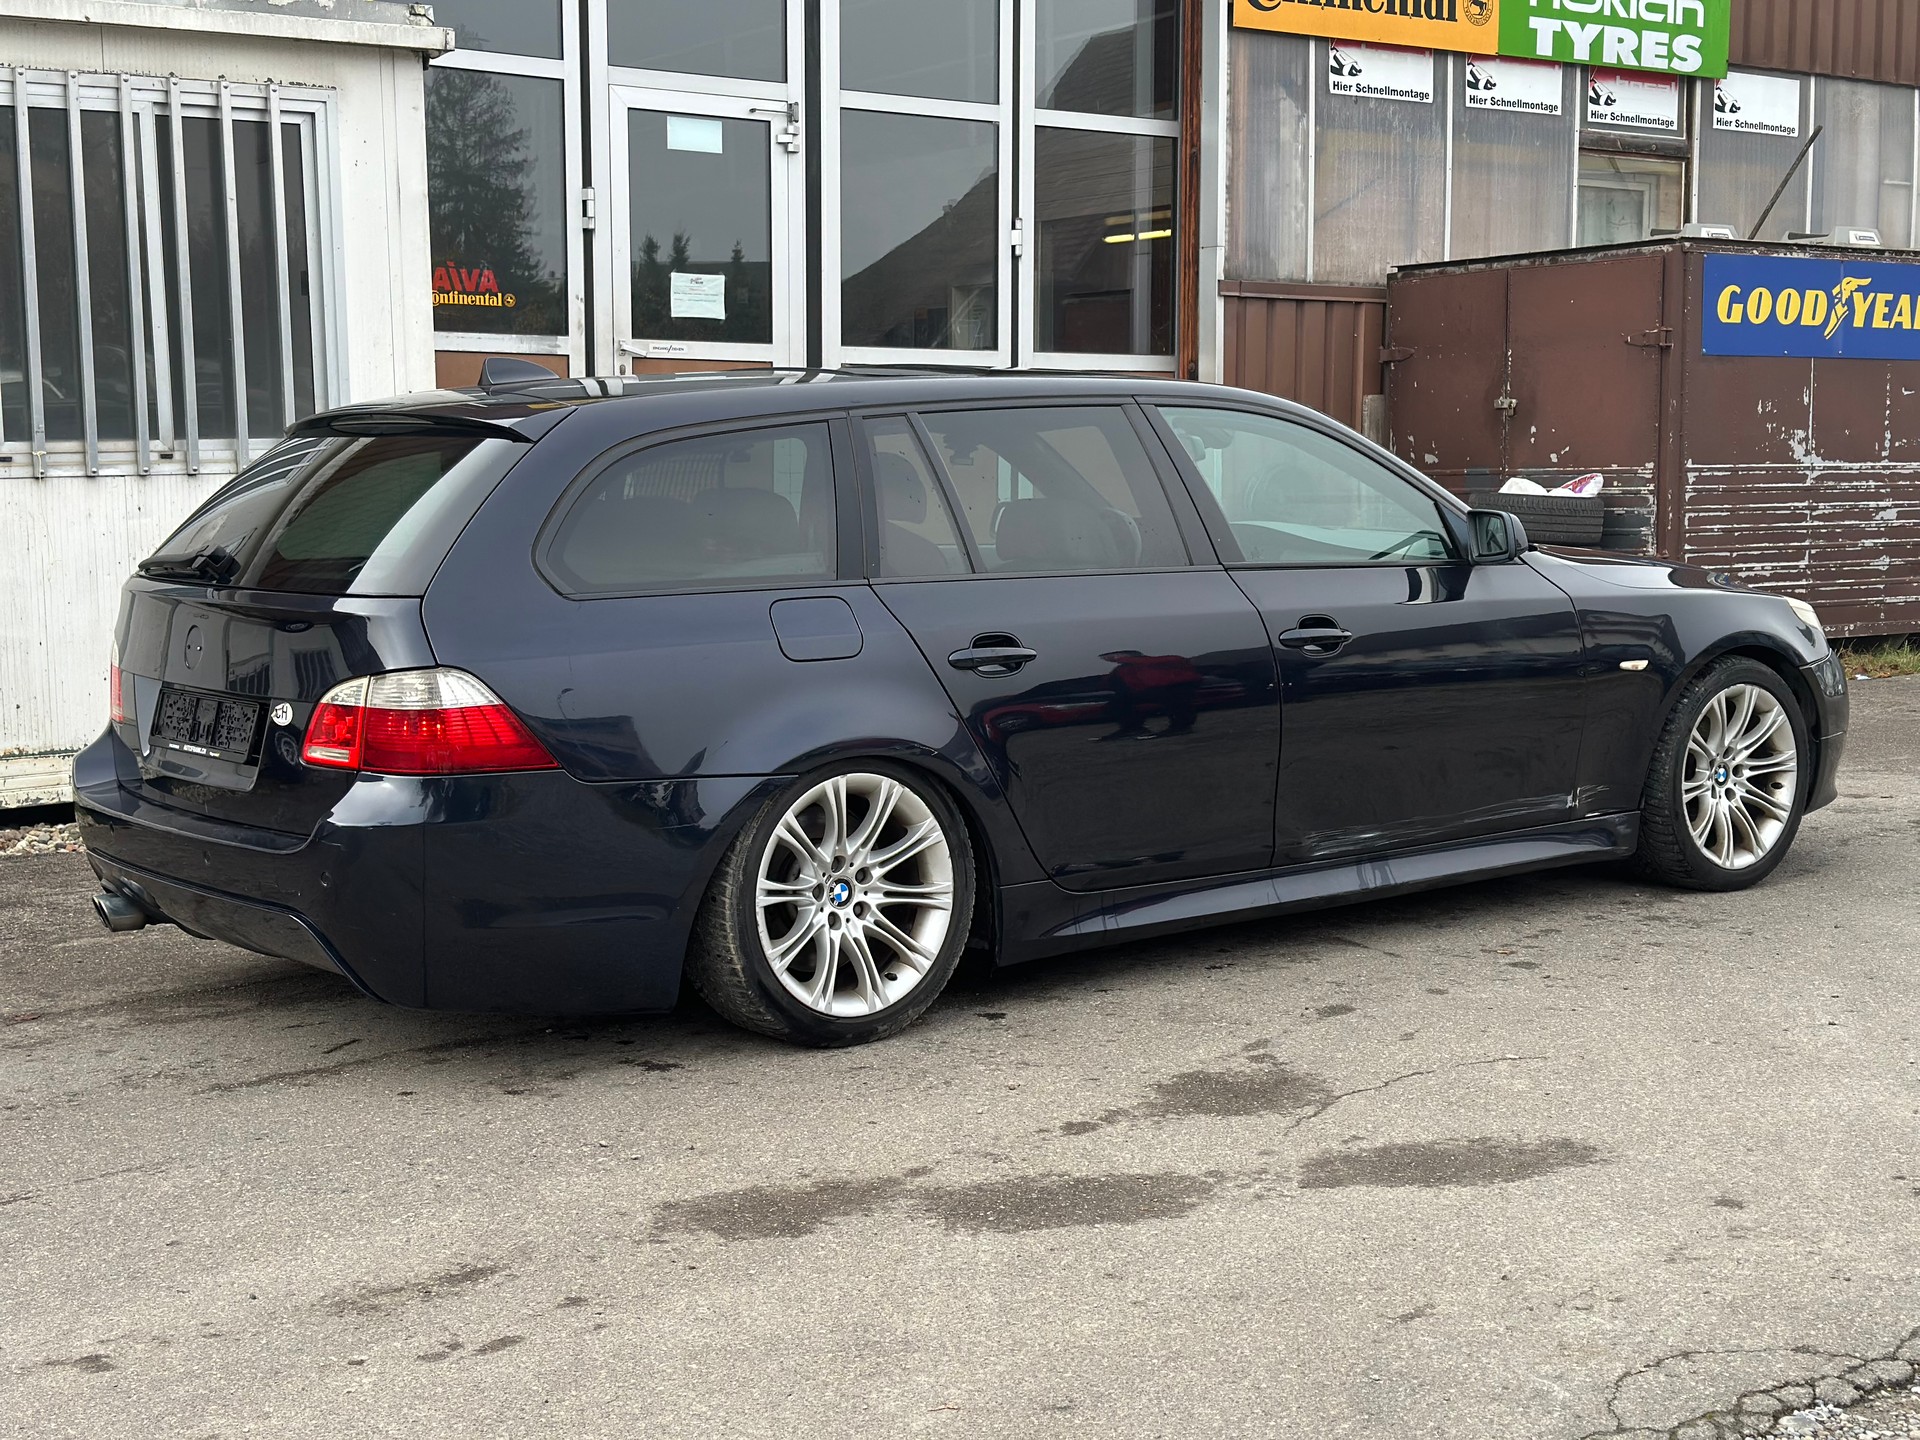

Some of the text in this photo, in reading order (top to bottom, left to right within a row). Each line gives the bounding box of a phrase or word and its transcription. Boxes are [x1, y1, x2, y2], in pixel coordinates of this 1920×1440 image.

[1529, 16, 1703, 73] TYRES
[1332, 80, 1430, 101] Hier Schnellmontage
[1469, 94, 1559, 114] Hier Schnellmontage
[1590, 109, 1675, 129] Hier Schnellmontage
[1716, 116, 1796, 136] Hier Schnellmontage
[1717, 284, 1920, 330] GOODYEA
